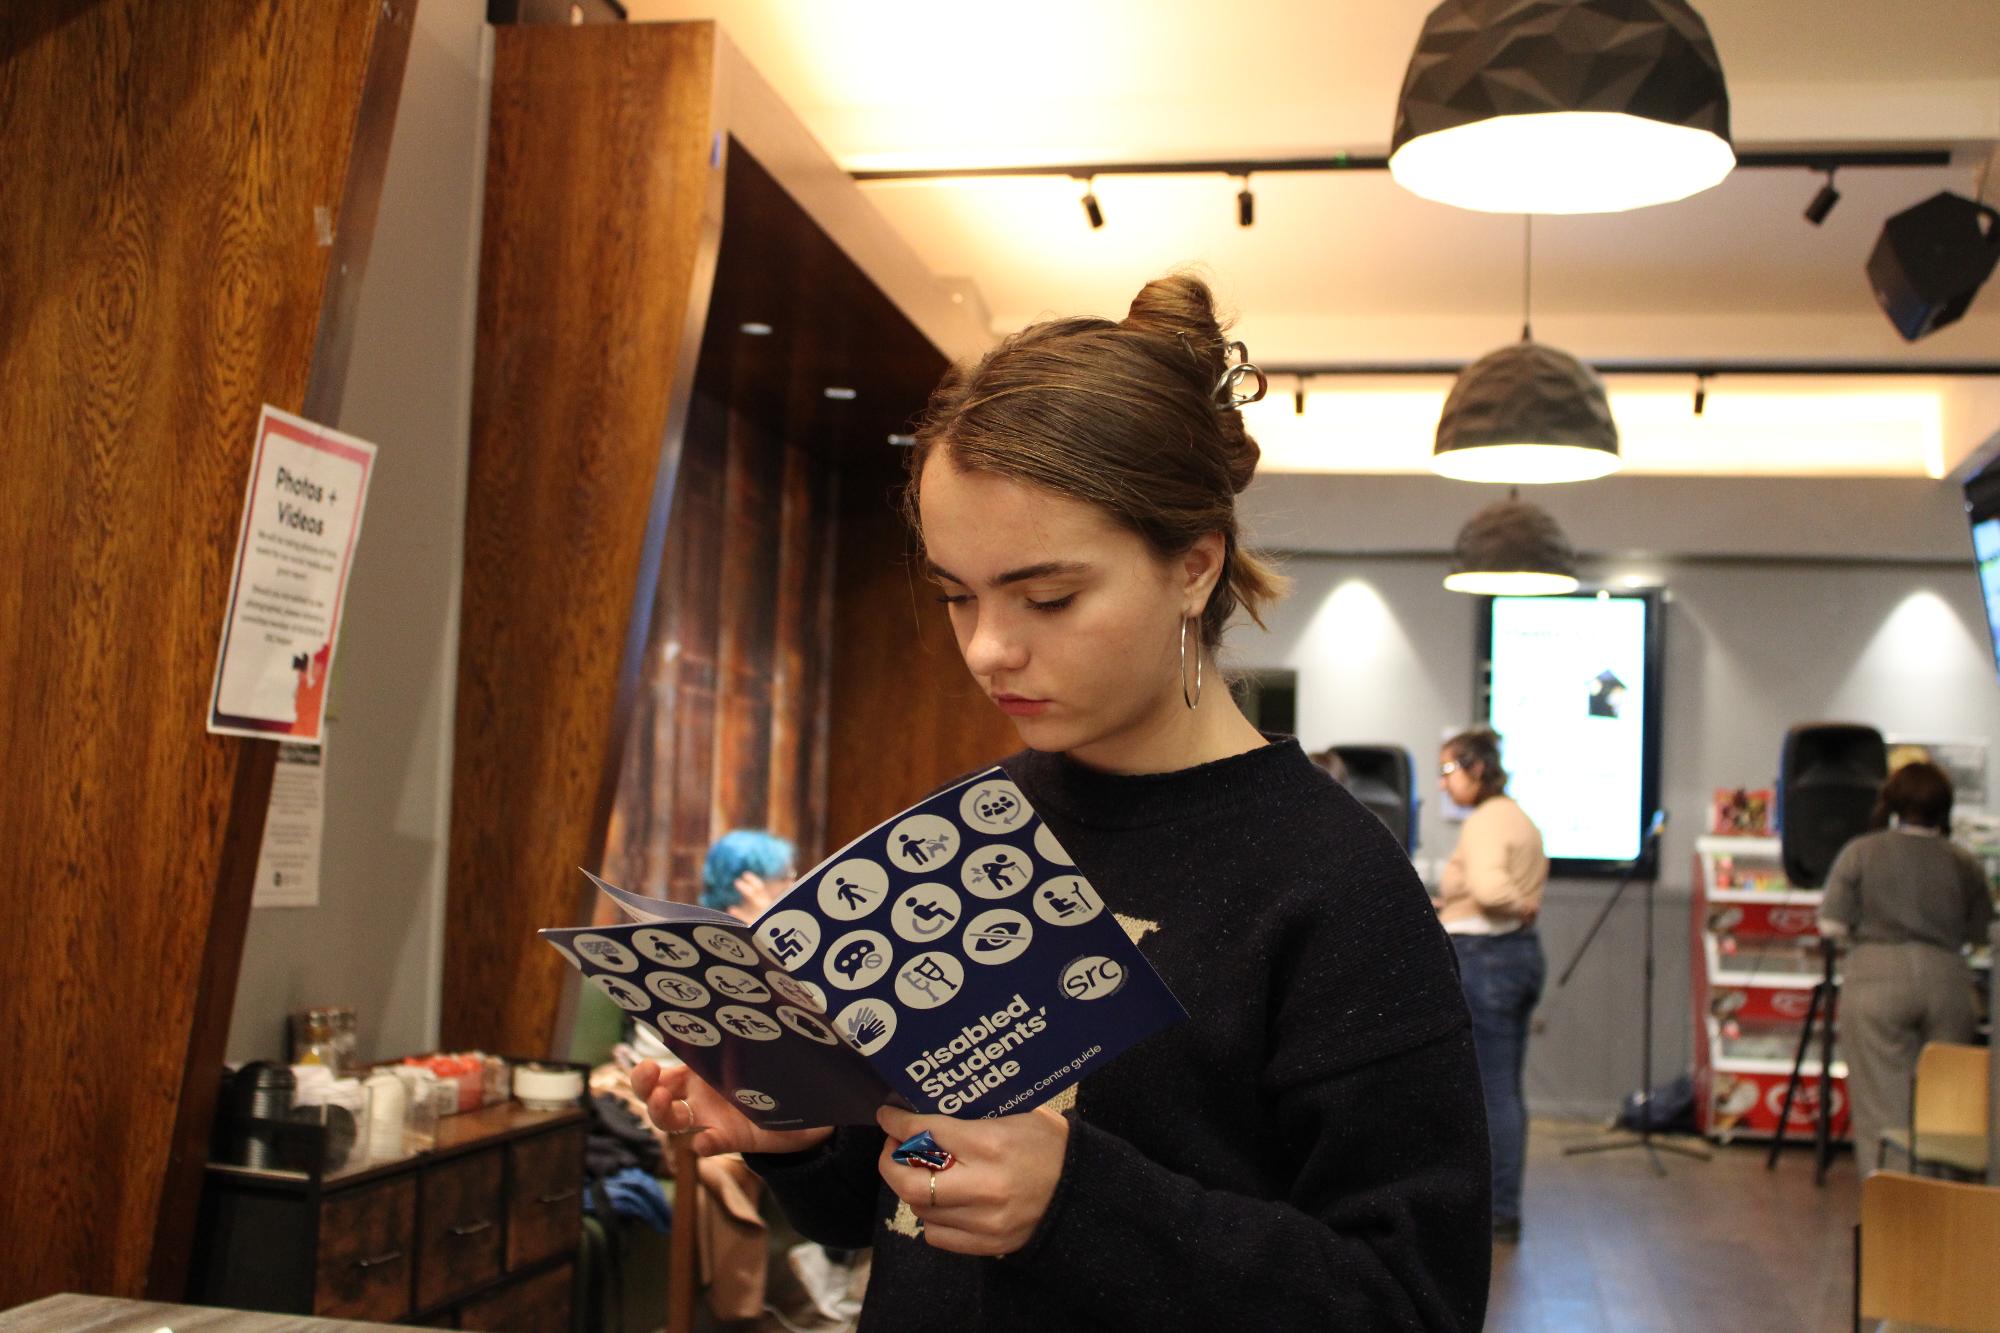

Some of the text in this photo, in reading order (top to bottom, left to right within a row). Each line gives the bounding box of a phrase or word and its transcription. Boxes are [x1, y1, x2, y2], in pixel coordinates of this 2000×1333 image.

[276, 466, 340, 508] Photos +
[278, 500, 325, 538] Videos
[1066, 958, 1119, 998] src
[905, 993, 1031, 1083] Disabled
[937, 1059, 1022, 1115] Guide
[998, 1088, 1035, 1115] Advice
[1033, 1064, 1071, 1093] Centre
[1071, 1044, 1103, 1071] guide
